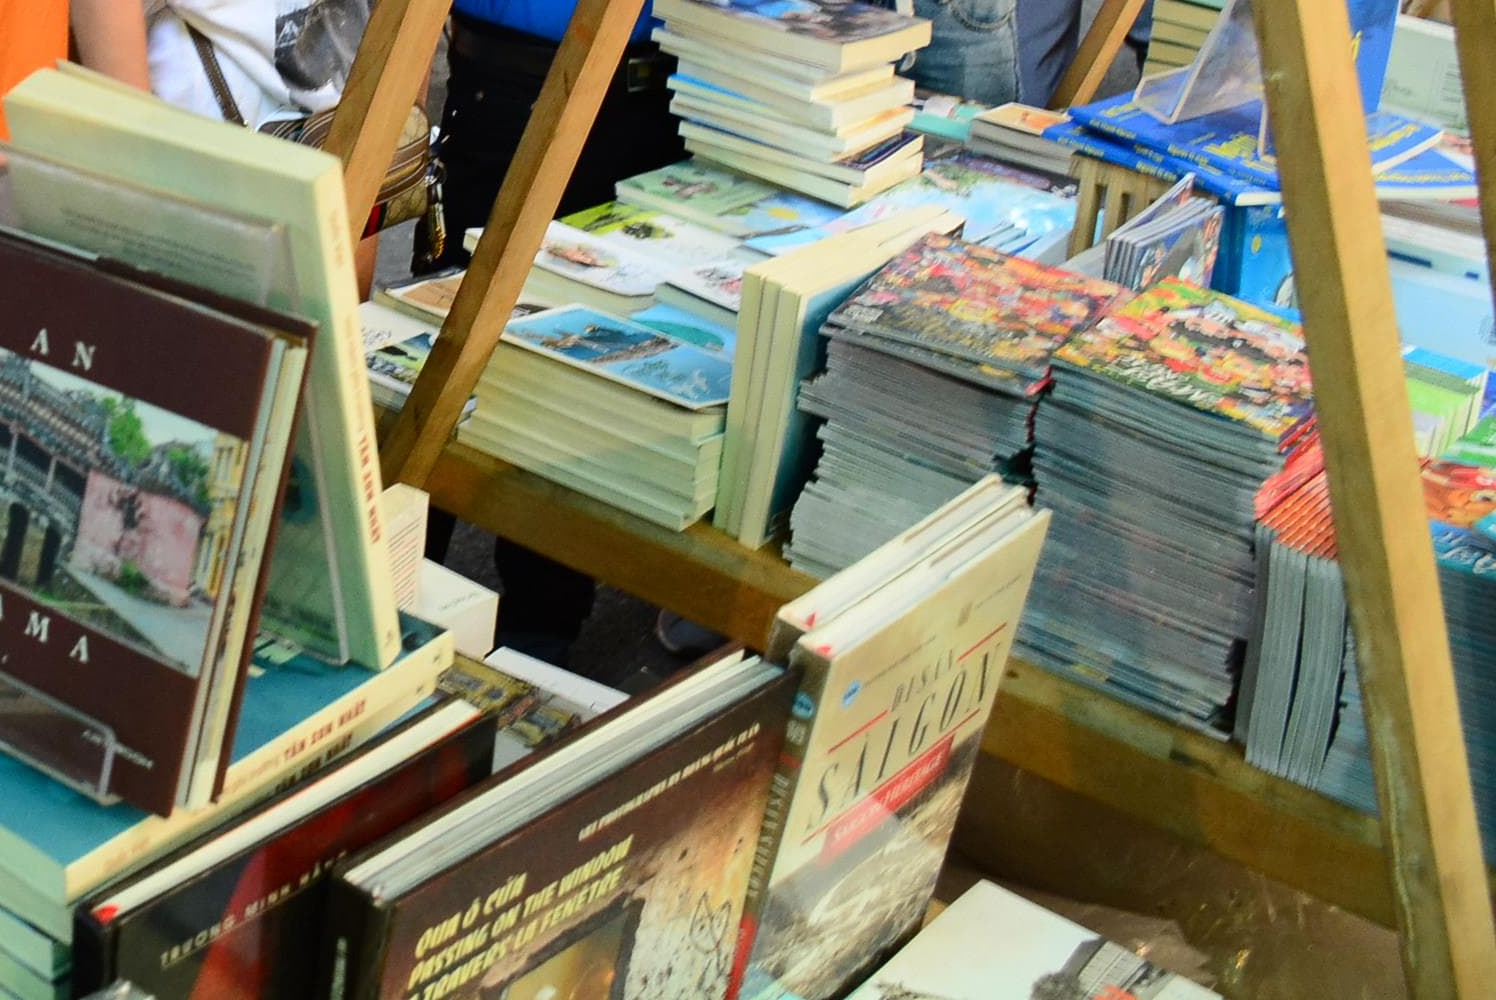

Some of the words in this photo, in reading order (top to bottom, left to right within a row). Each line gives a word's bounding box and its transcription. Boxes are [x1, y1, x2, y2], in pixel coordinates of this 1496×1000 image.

[30, 327, 96, 371] AN
[407, 923, 489, 992] PASSING
[490, 902, 522, 940] ON
[522, 879, 559, 920] THE
[556, 834, 635, 898] WINDOW
